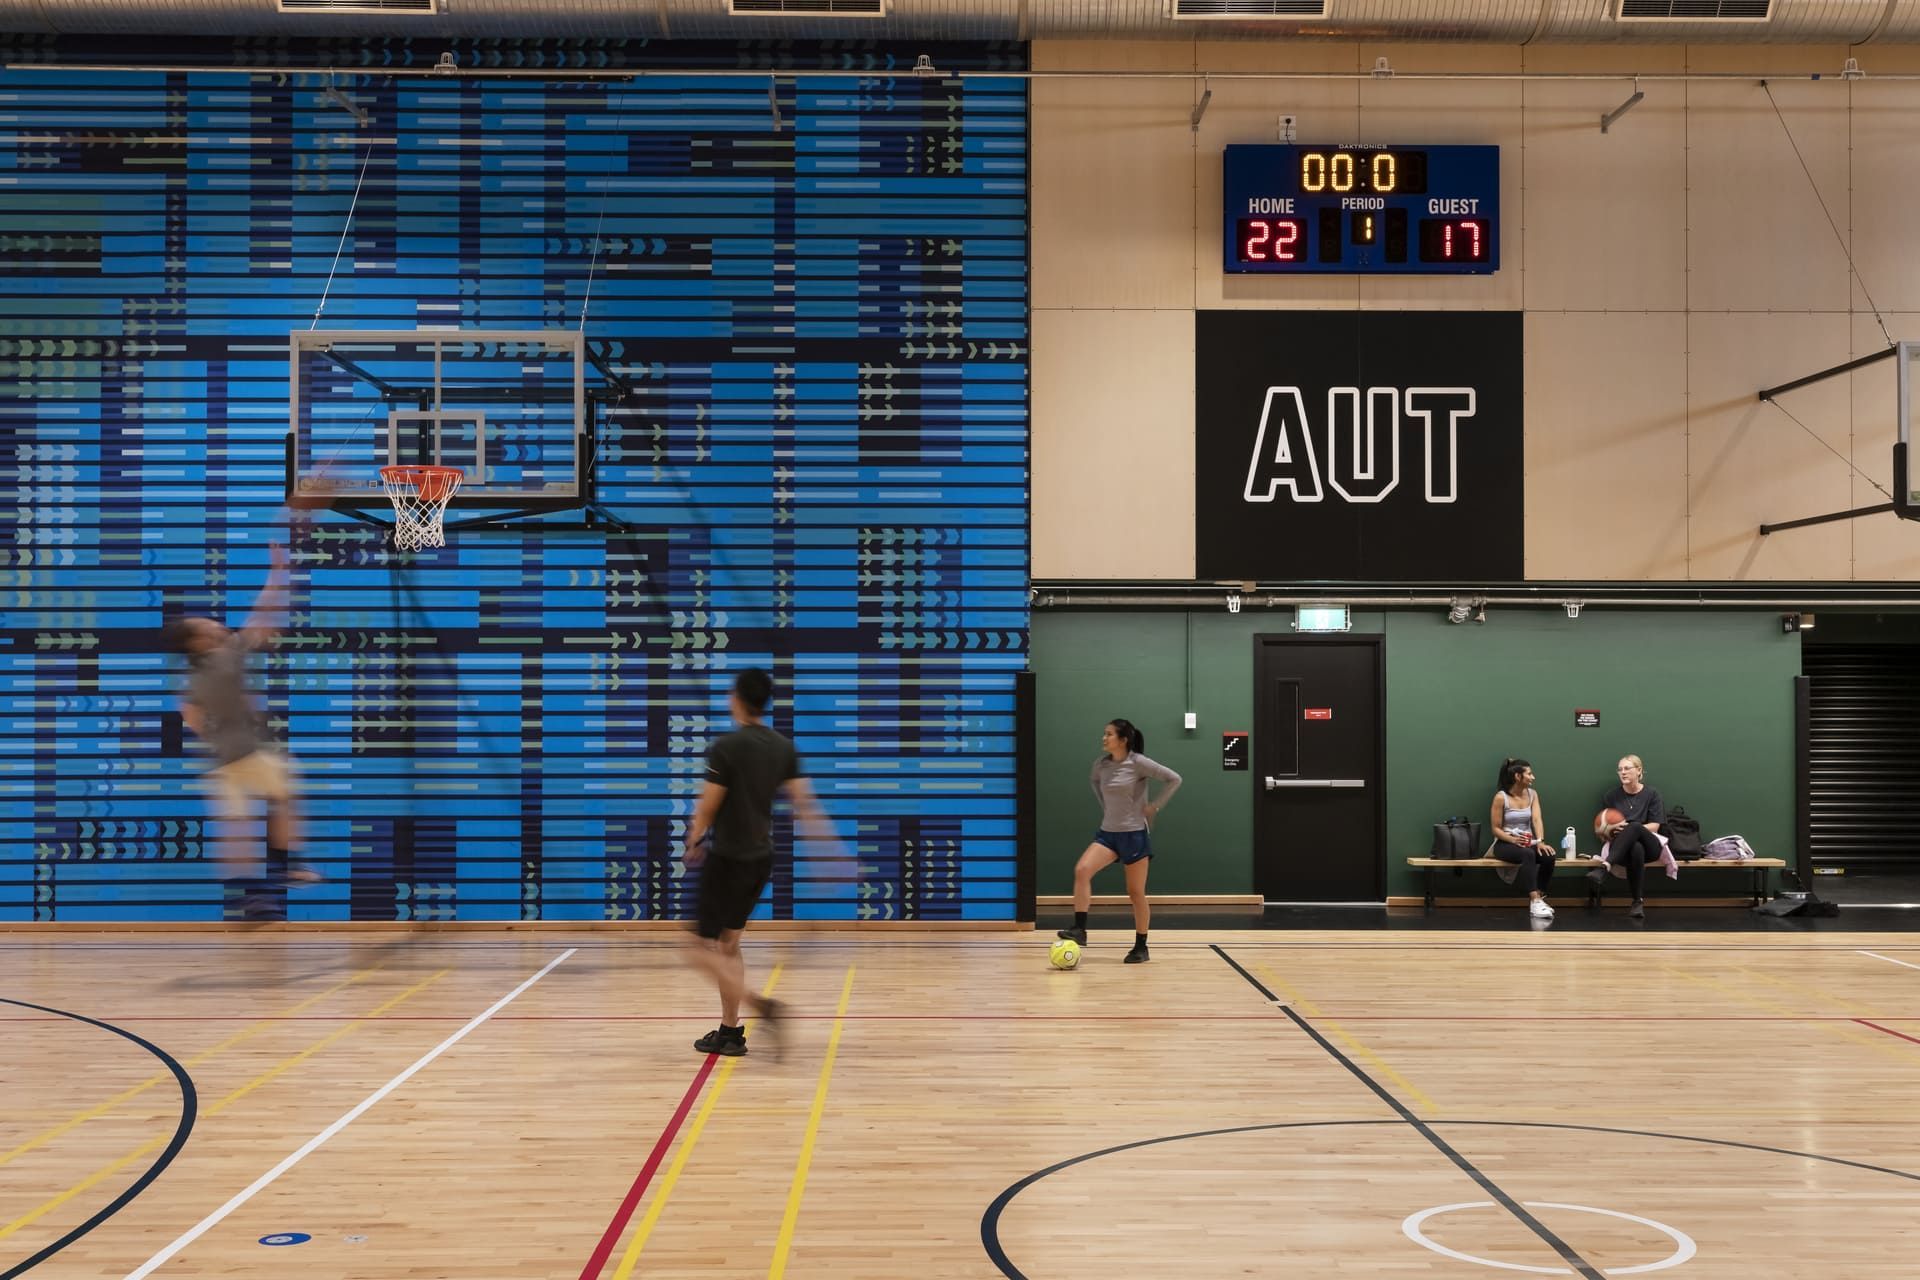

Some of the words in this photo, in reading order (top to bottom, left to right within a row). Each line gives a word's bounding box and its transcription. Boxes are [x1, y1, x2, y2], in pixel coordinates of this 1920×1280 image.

[1248, 198, 1295, 214] HOME
[1341, 197, 1385, 211] PERIOD
[1428, 198, 1480, 215] GUEST
[1247, 221, 1298, 260] 22
[1364, 216, 1373, 241] 1
[1444, 221, 1481, 258] 17
[1243, 386, 1477, 504] AUT
